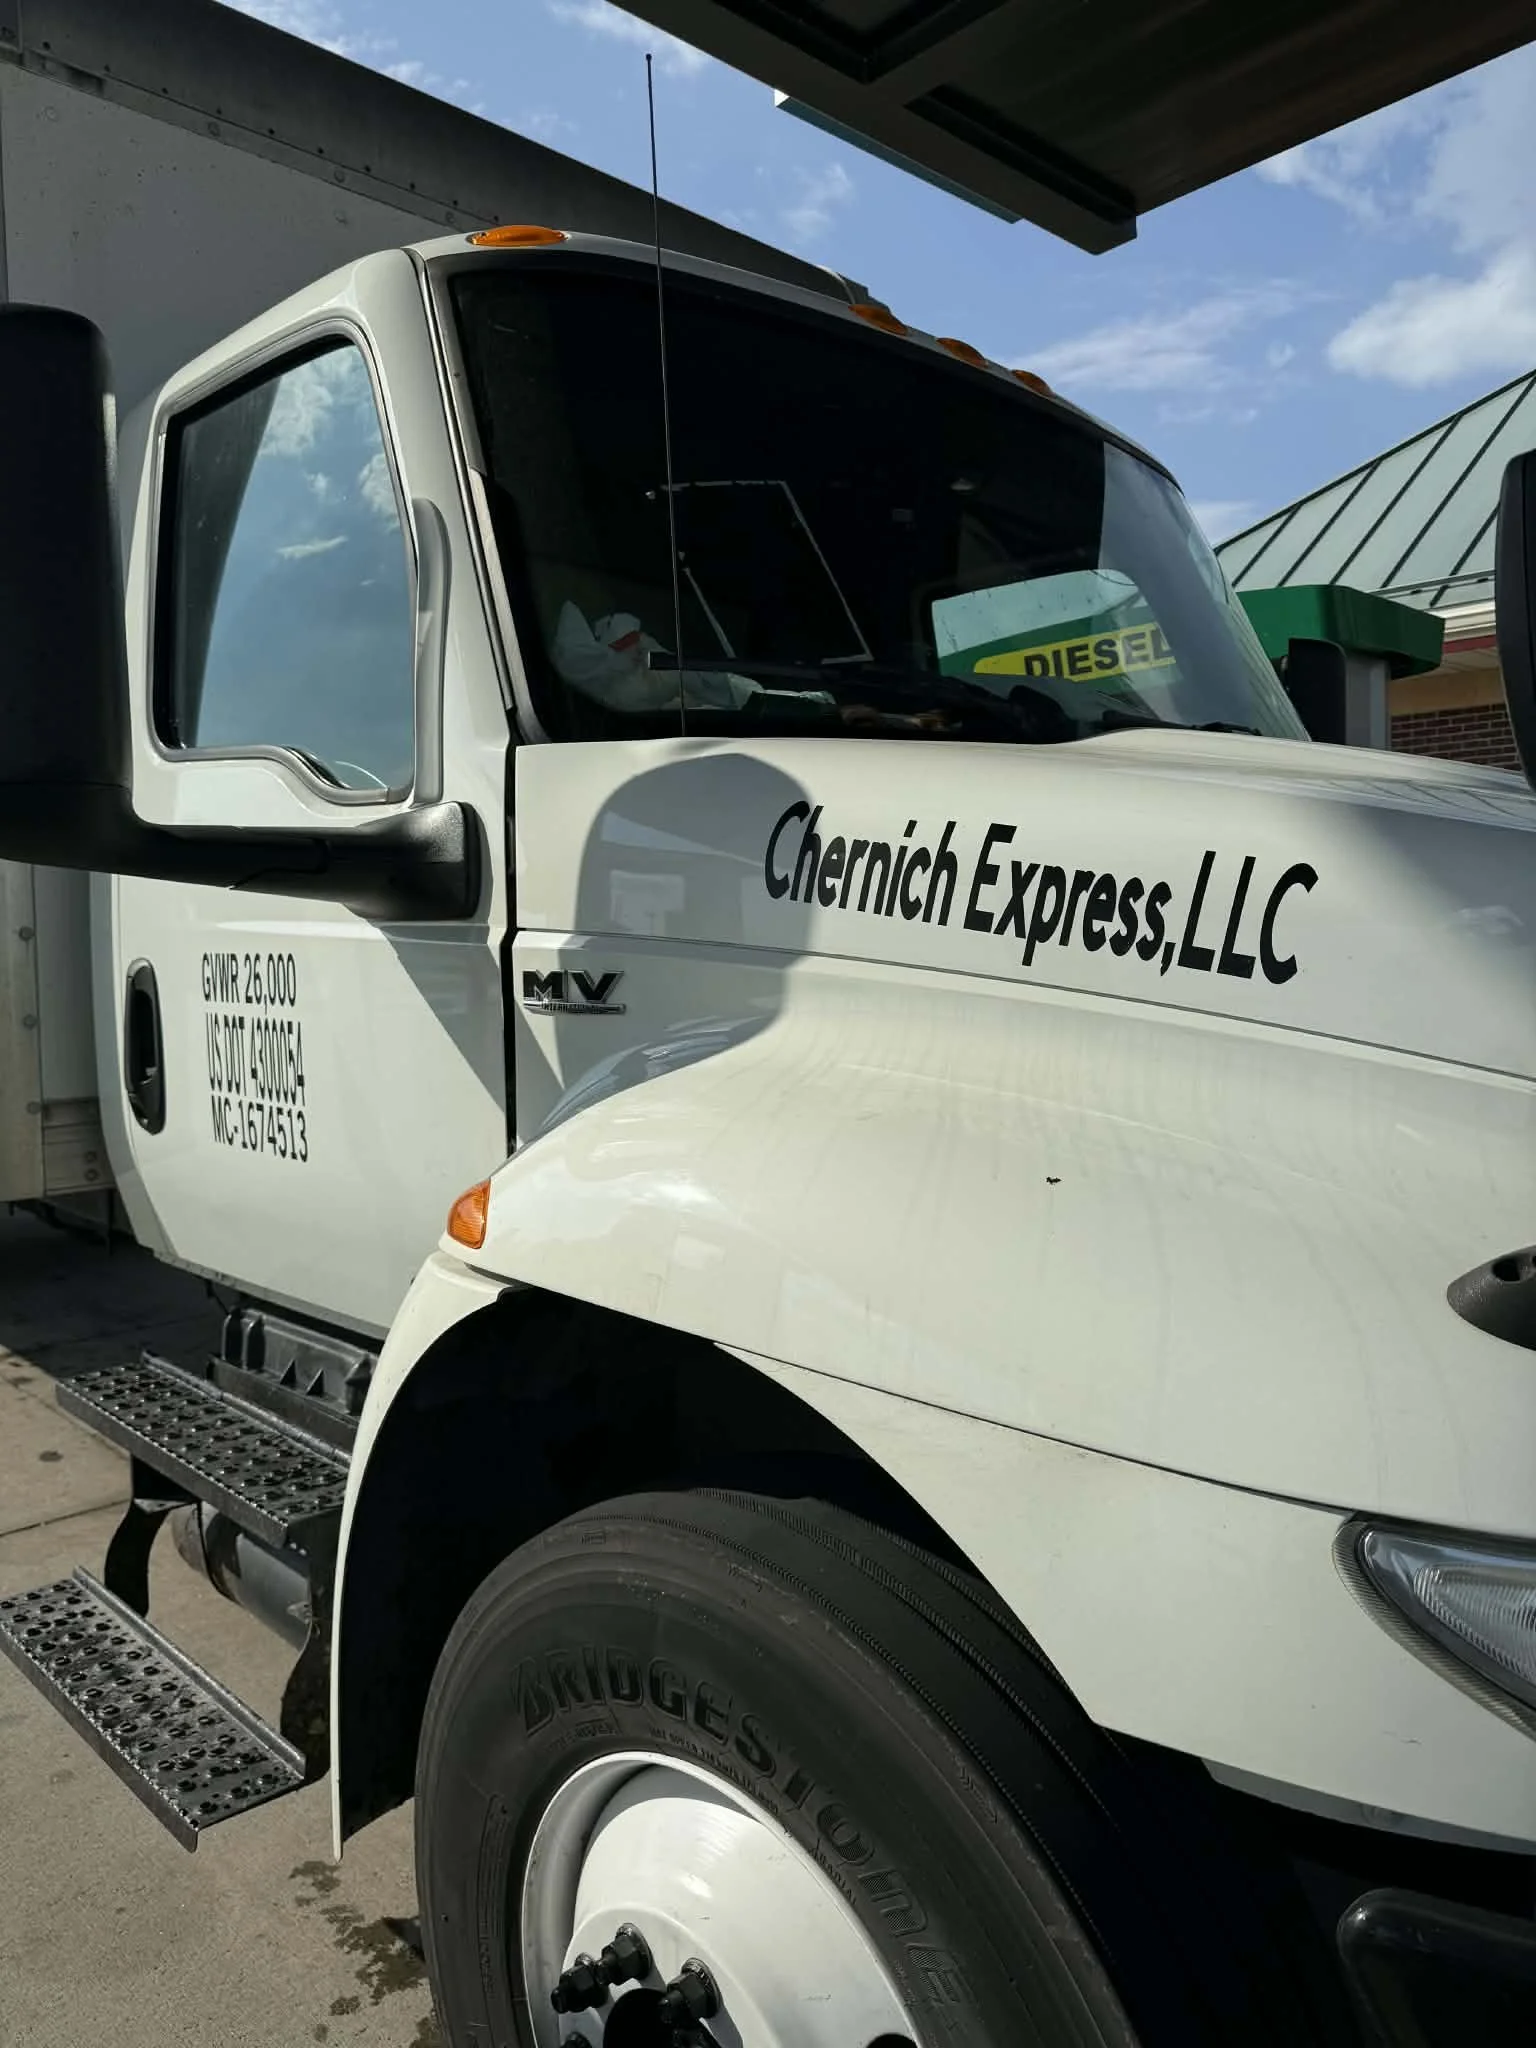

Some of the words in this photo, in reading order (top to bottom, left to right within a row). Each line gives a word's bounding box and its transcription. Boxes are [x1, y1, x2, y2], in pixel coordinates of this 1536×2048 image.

[1023, 626, 1171, 680] DIESEL
[764, 799, 959, 927] Chernich
[201, 952, 240, 1004] GVWR
[244, 952, 297, 1016] 26,000
[521, 968, 625, 1003] MV
[250, 1016, 306, 1107] 4300054
[211, 1094, 309, 1163] MC-1674513
